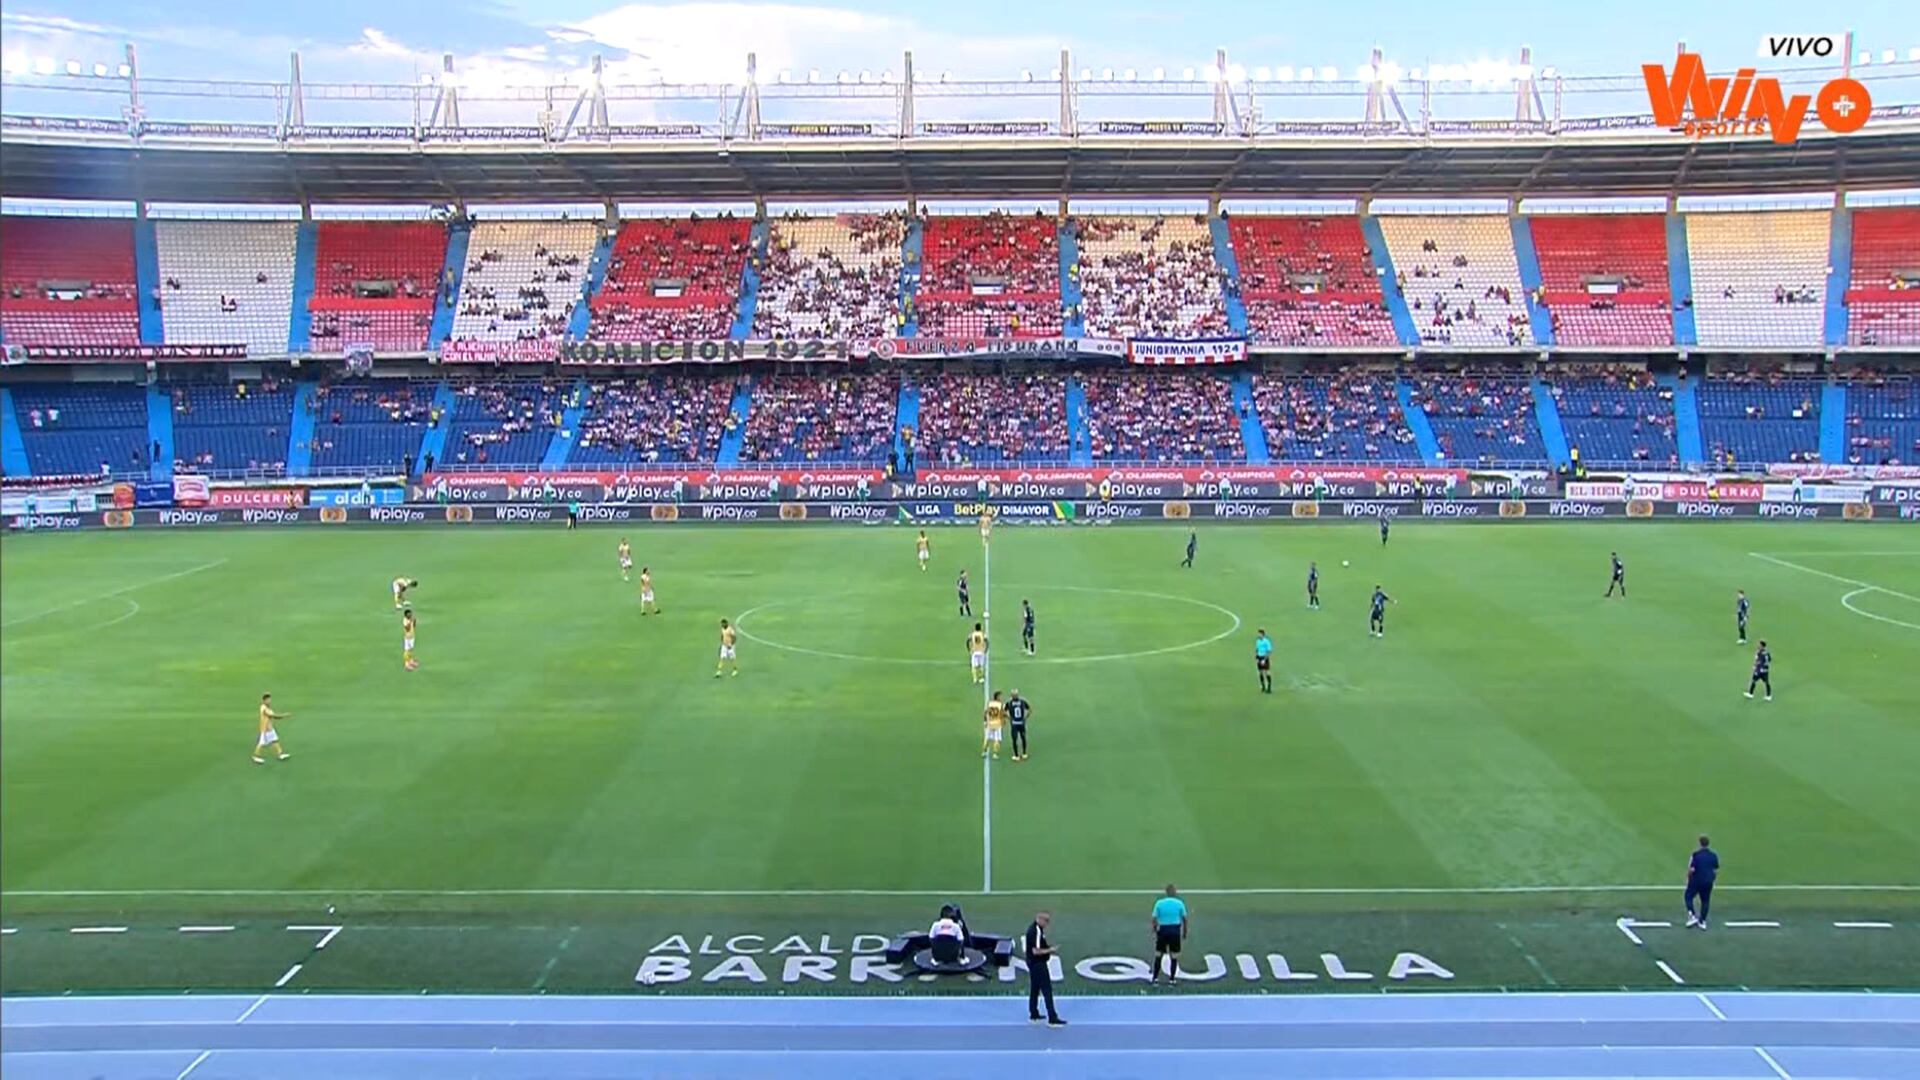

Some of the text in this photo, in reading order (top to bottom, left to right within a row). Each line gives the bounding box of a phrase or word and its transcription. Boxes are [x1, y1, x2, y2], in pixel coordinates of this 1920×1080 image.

[1135, 344, 1206, 355] JUNIORMANIA
[1125, 472, 1184, 480] OLIMPICA
[426, 486, 486, 501] Wlay.co
[520, 486, 582, 501] Wpay.co
[905, 483, 967, 498] Wplay.co
[1002, 482, 1064, 497] Wplay.co
[1102, 483, 1161, 498] play.co
[1484, 481, 1546, 497] Wply.co
[1680, 487, 1760, 497] DULERNA
[243, 507, 298, 522] Wplay.co
[370, 507, 424, 521] Wplay.co
[496, 506, 550, 521] Wplay.co
[702, 505, 757, 520] Wplay.co
[830, 504, 886, 518] Wplay.co
[915, 504, 1049, 518] LIGA BetPlay DIMAYOR
[1215, 502, 1270, 517] Wplay.co
[1343, 502, 1398, 517] Wplay.co
[1422, 502, 1478, 516] Wplay.co
[1550, 501, 1604, 516] Wplay.co
[1677, 502, 1733, 517] Wplay.co
[159, 509, 218, 524] Wplay.co
[635, 951, 1455, 984] BARRNQUILLA
